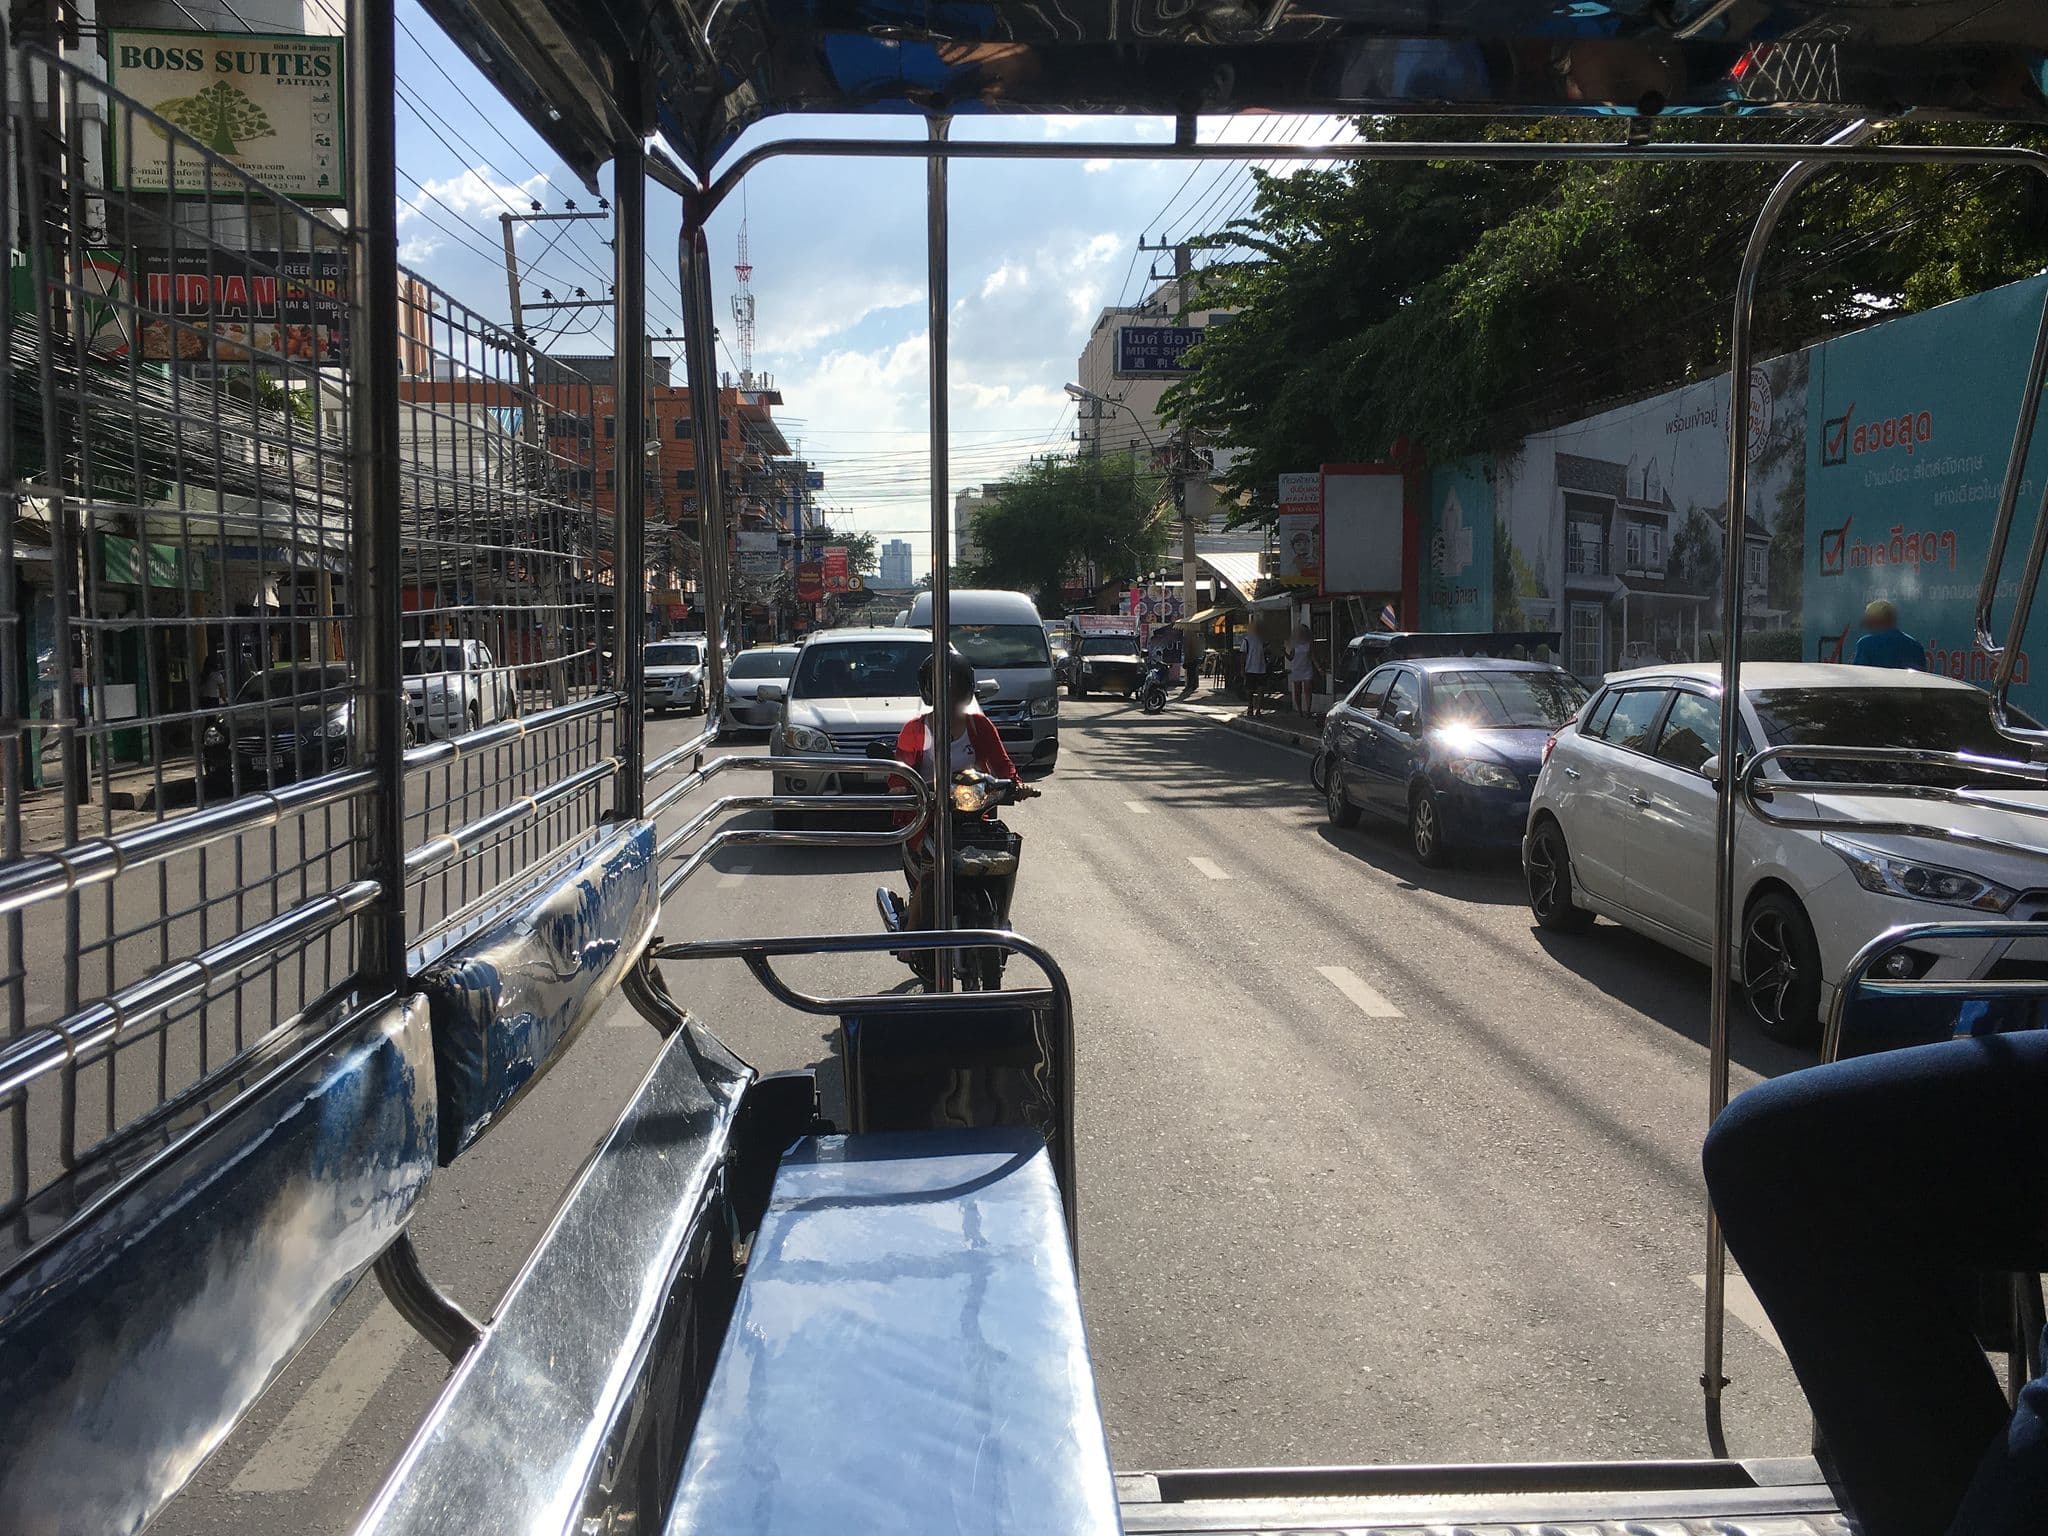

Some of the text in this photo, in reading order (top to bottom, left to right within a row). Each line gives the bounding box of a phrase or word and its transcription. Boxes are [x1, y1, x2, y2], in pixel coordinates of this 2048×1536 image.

[120, 45, 332, 78] BOSS SUITES
[276, 78, 330, 87] PATTAYA
[148, 273, 278, 319] INDIAN
[302, 301, 310, 310] &
[1126, 346, 1158, 356] MIKE
[1852, 410, 1933, 456] สวยสุด
